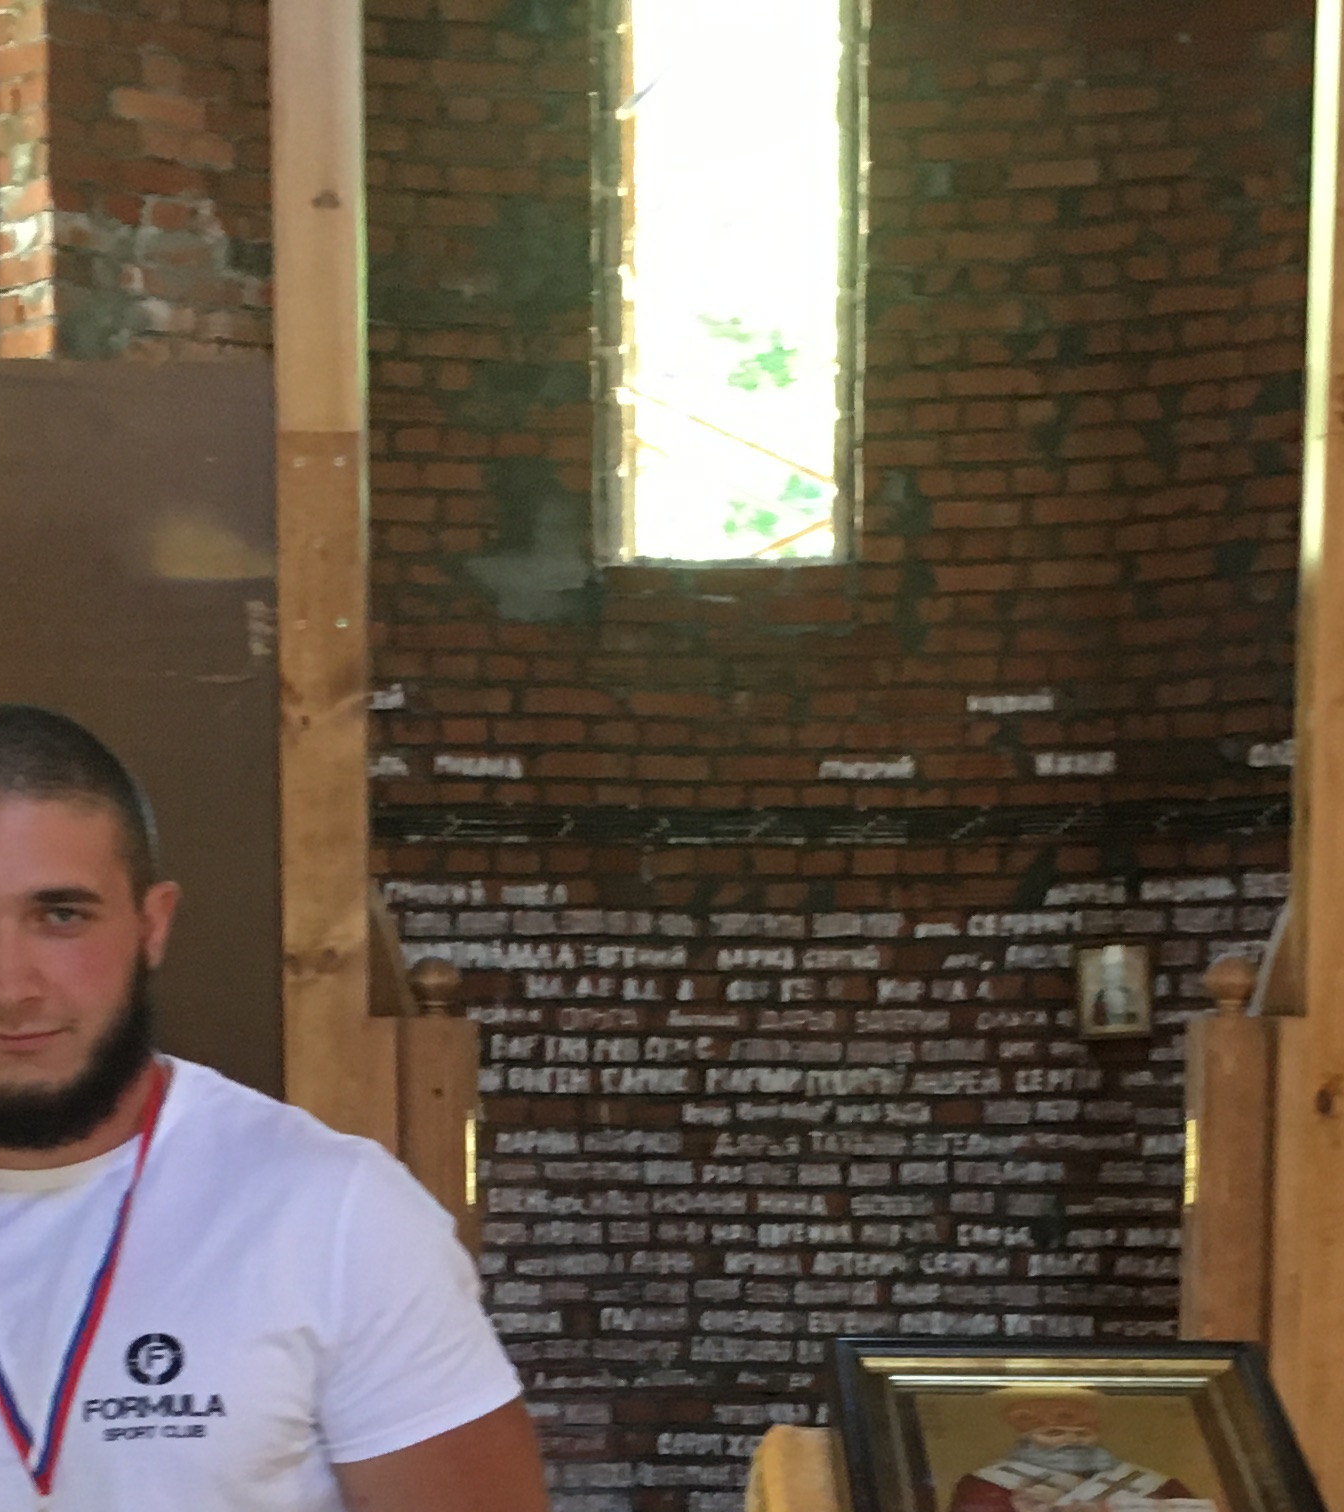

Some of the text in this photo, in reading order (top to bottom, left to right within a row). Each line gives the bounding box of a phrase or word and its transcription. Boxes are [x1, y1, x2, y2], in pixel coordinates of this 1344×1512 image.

[83, 1394, 226, 1422] FORMULA
[104, 1425, 207, 1441] SPORT CLUB
